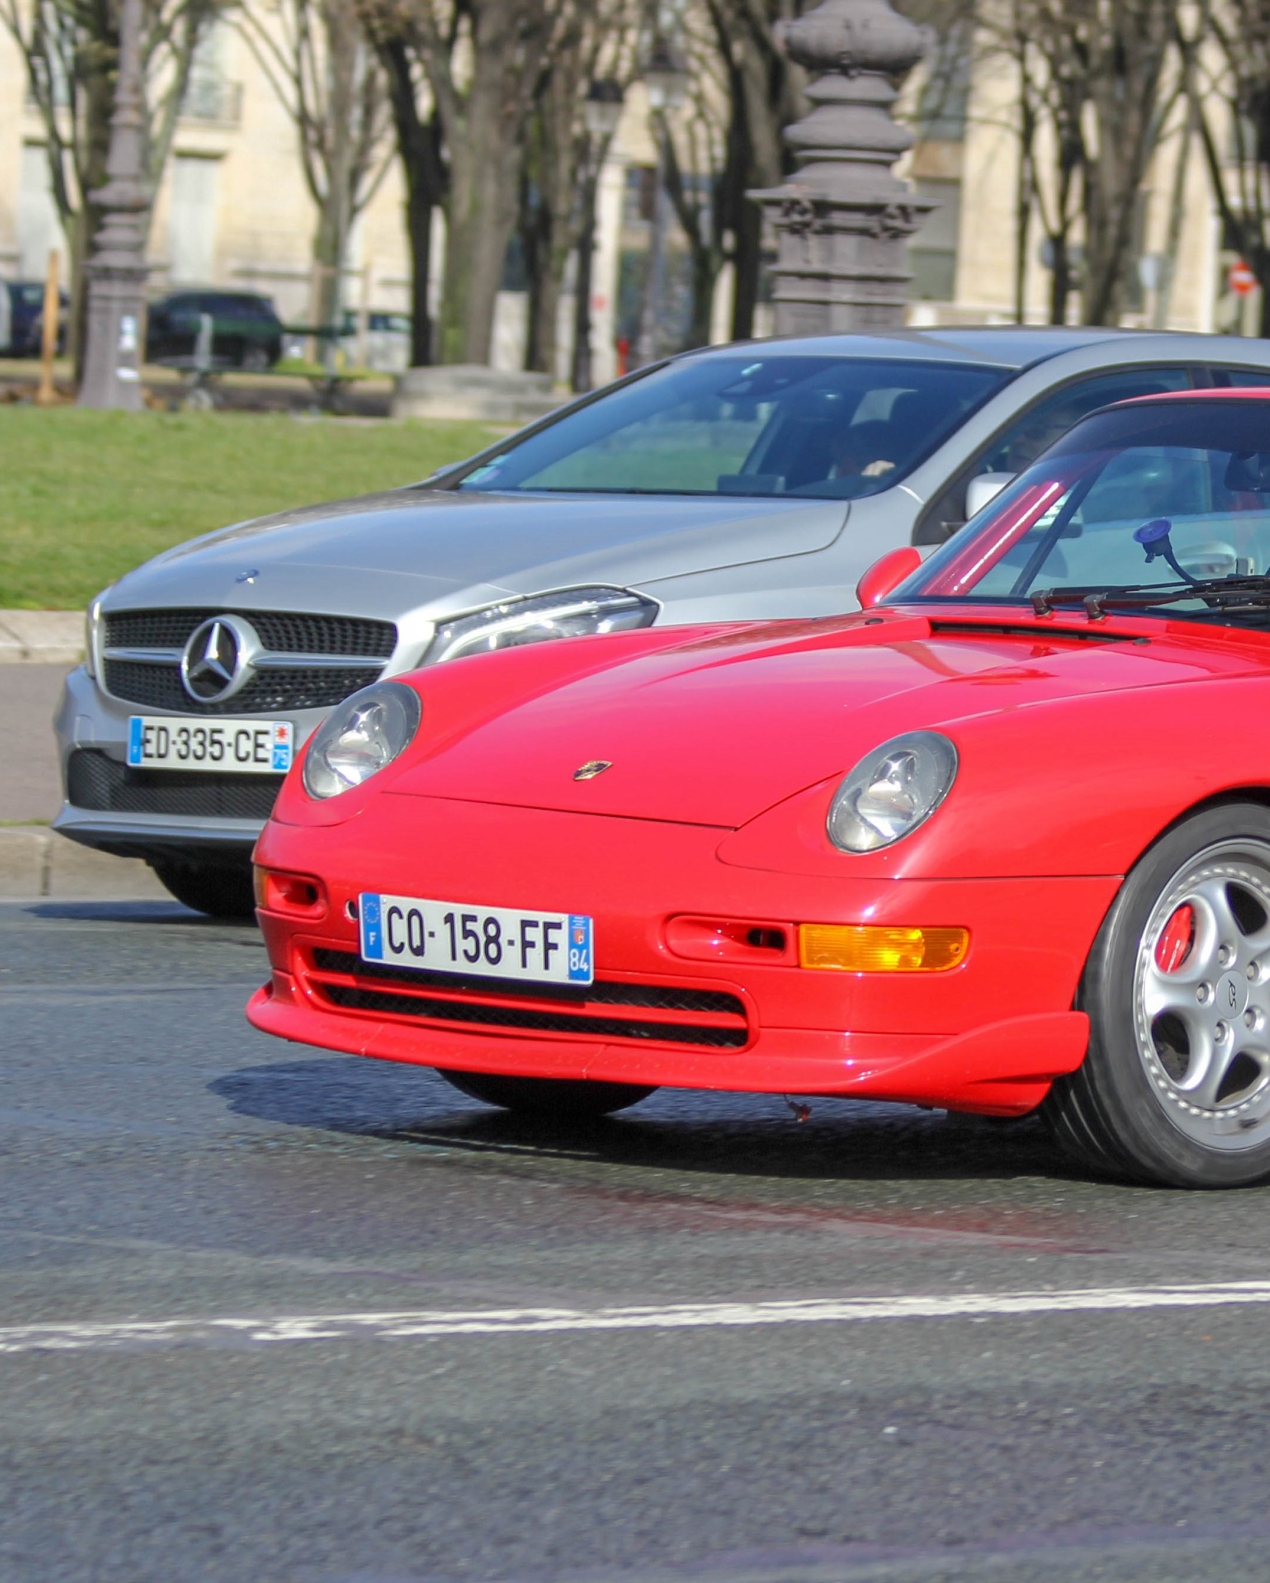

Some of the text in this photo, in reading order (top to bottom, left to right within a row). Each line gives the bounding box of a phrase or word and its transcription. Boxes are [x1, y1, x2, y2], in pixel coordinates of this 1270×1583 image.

[143, 725, 270, 763] ED-335-CE
[273, 751, 287, 766] 75
[369, 931, 377, 945] F
[387, 905, 563, 970] CQ-158-FF
[570, 948, 589, 973] 84
[1227, 978, 1237, 1011] RS
